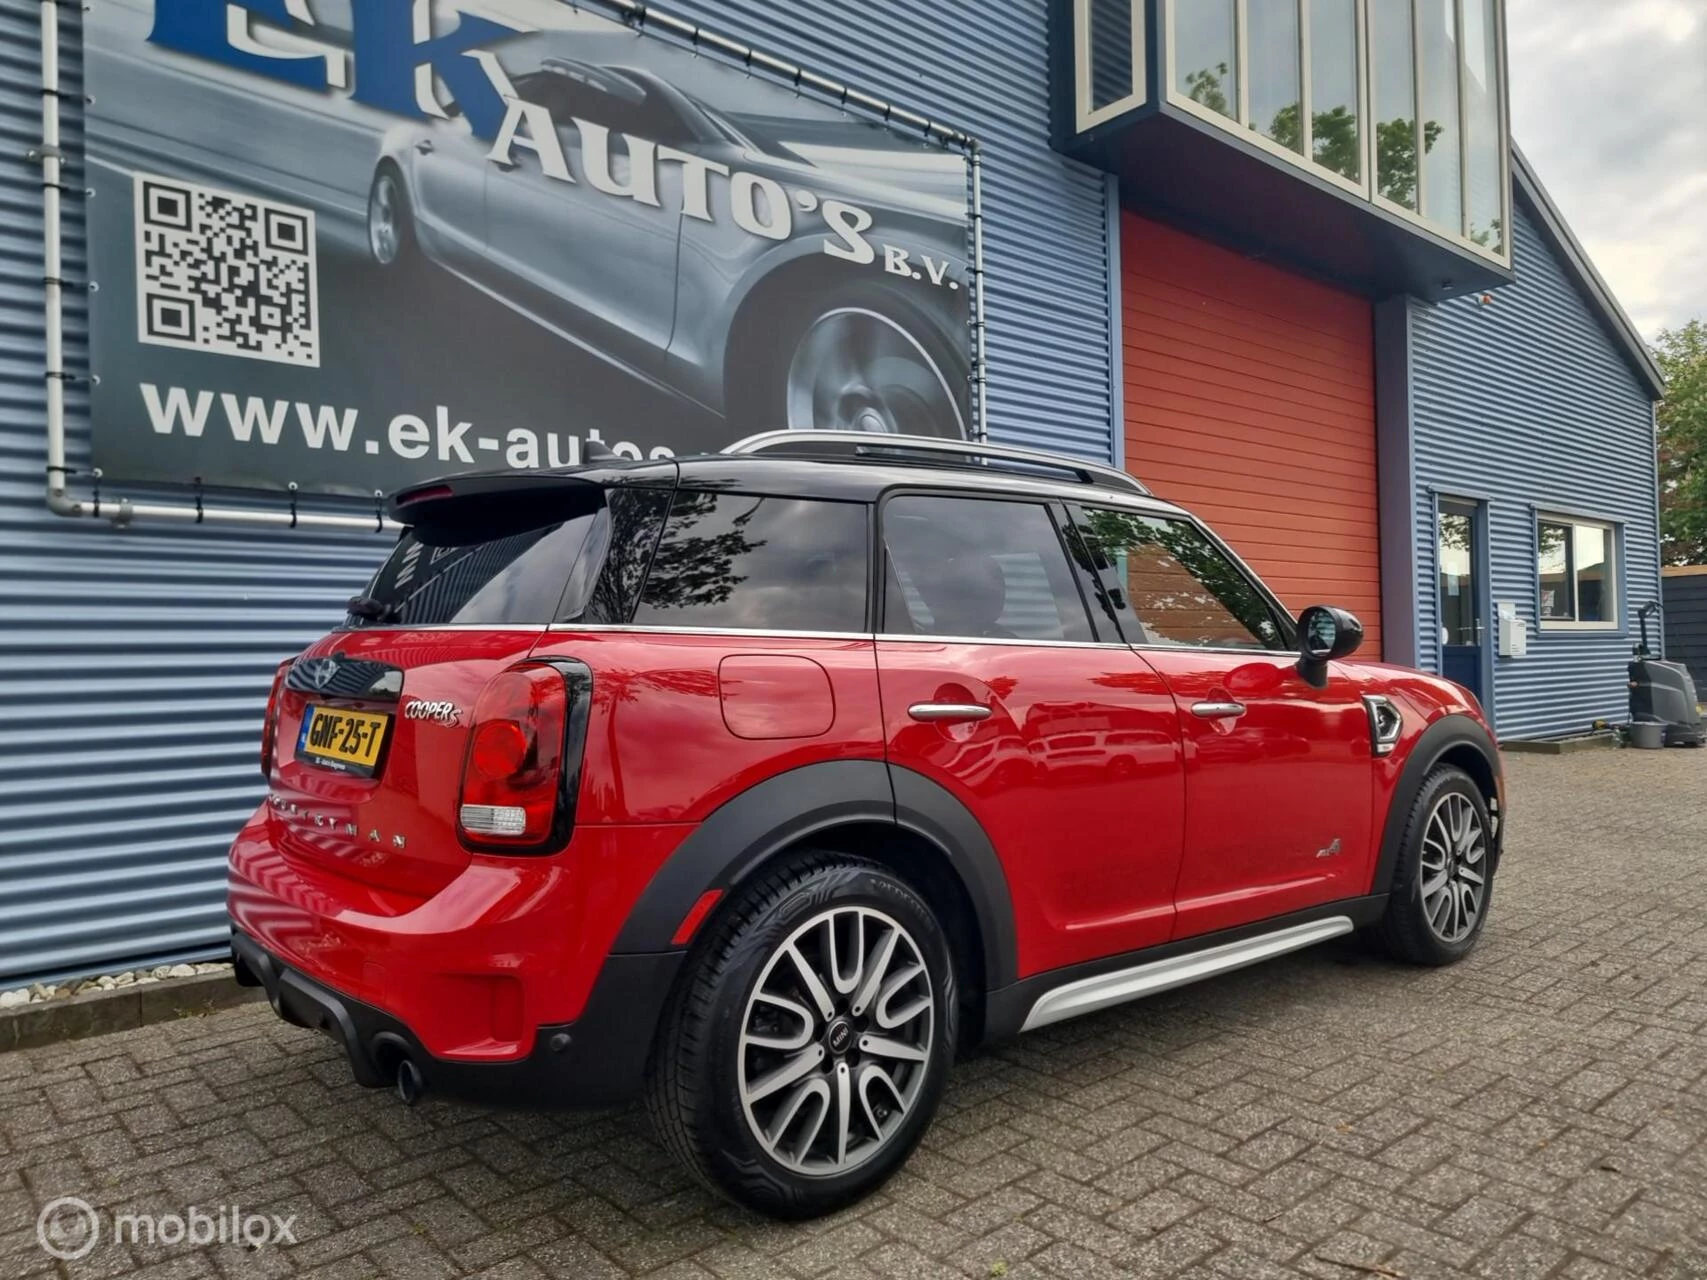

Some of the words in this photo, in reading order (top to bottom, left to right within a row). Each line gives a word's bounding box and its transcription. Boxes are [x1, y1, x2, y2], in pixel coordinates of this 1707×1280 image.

[146, 0, 541, 142] EK
[882, 244, 959, 290] B.V.
[404, 700, 454, 721] COOPER
[310, 713, 381, 758] GNF-25-T
